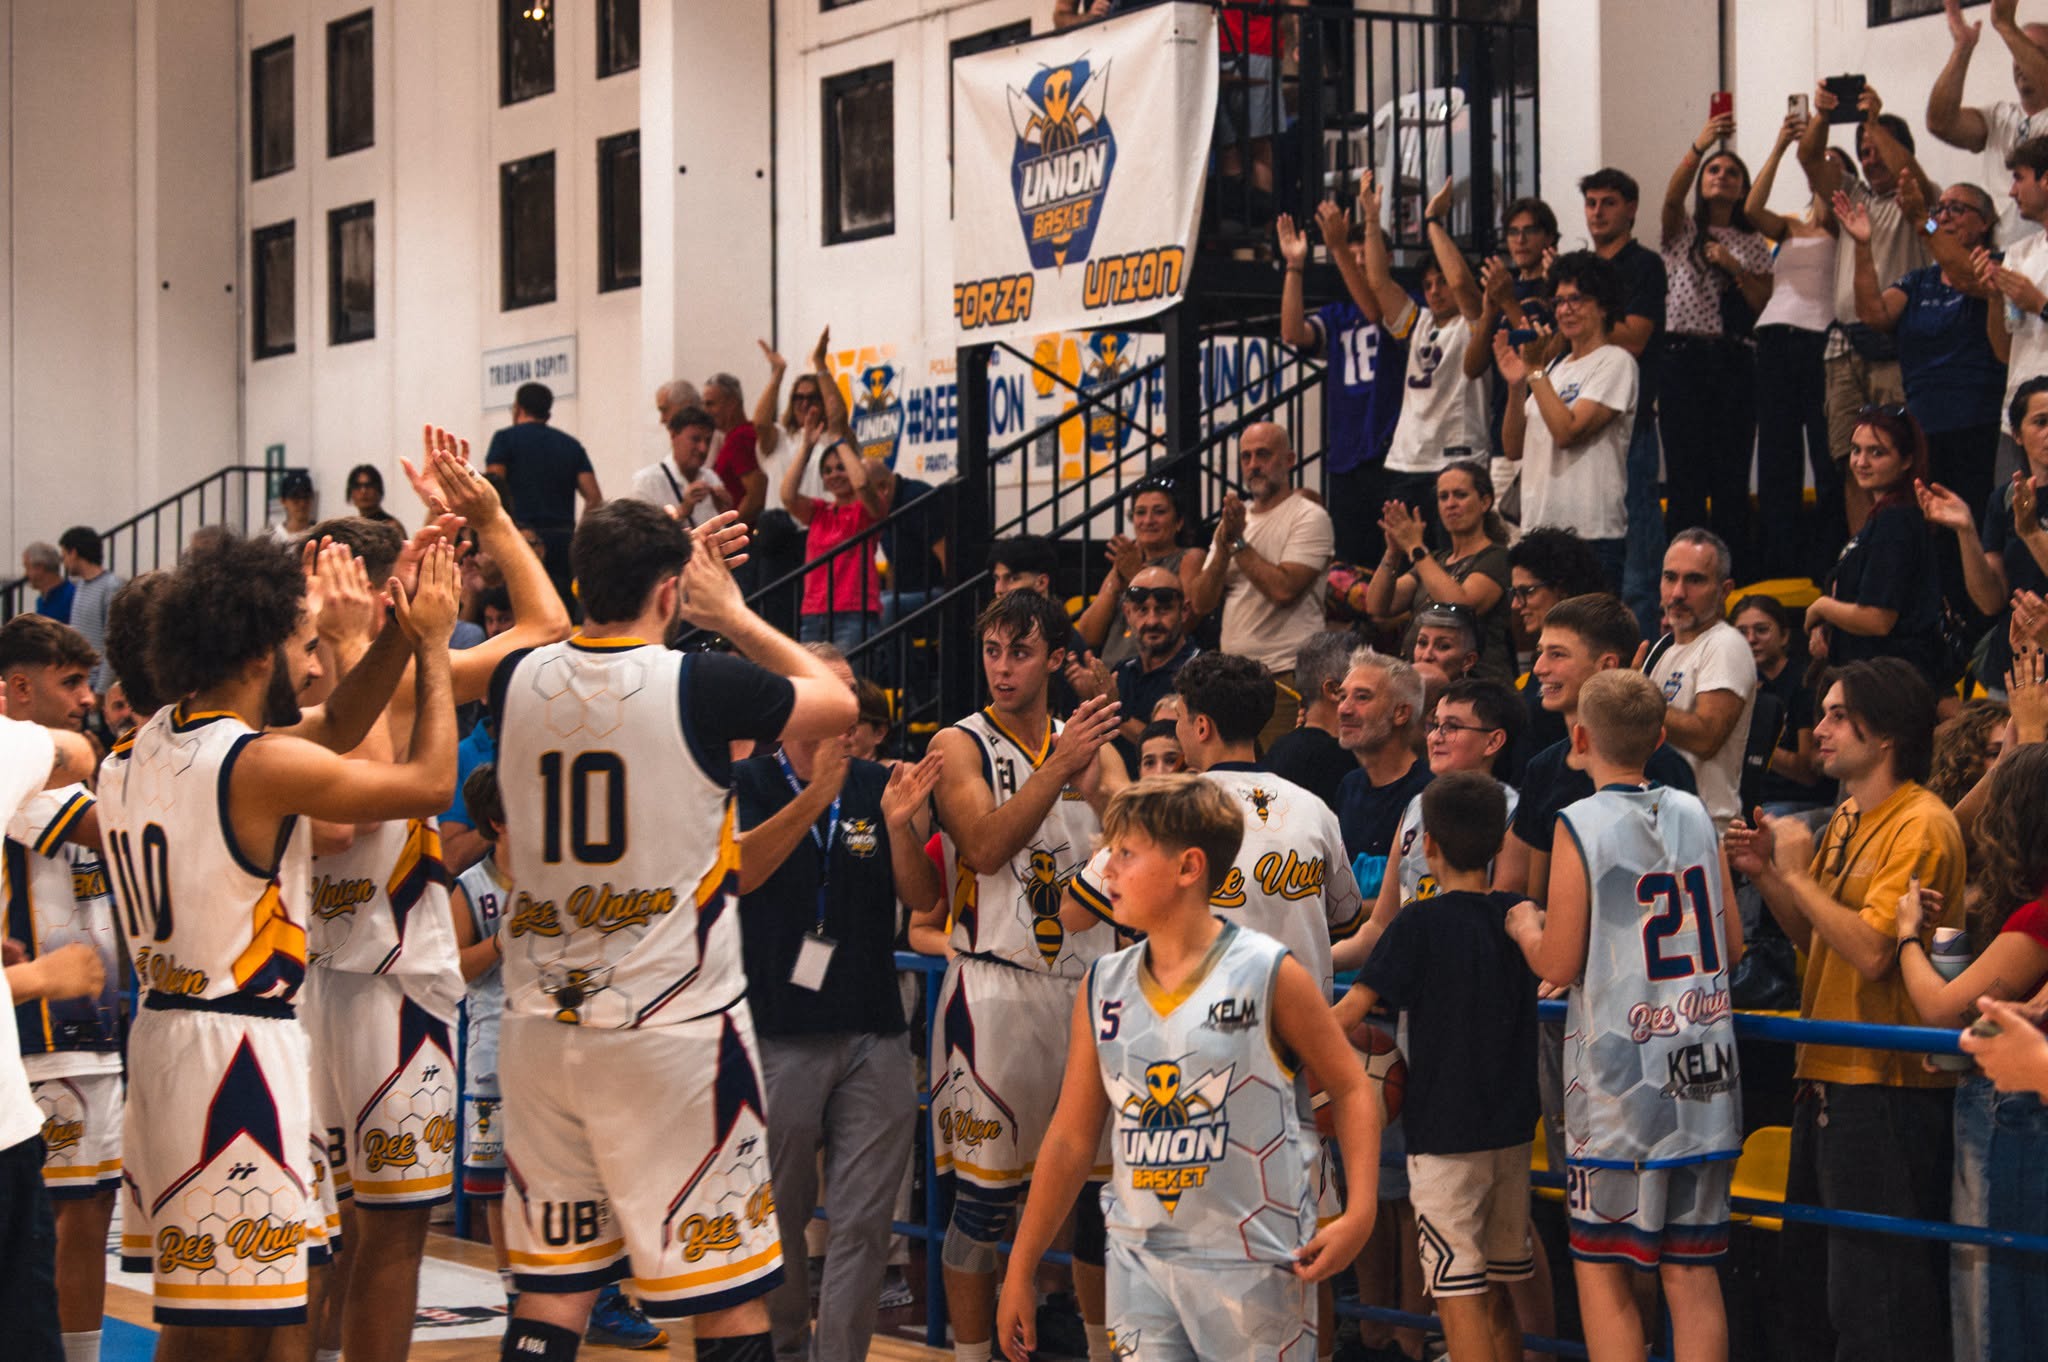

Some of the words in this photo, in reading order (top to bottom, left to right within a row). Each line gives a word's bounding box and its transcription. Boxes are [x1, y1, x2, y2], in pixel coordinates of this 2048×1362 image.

[1022, 142, 1107, 208] UNION
[1032, 199, 1092, 240] BASKET
[1083, 244, 1185, 310] UNION
[490, 360, 530, 387] TRIBUNA
[535, 353, 567, 378] OSPITI
[856, 411, 900, 444] UNION
[539, 750, 628, 866] 10
[567, 883, 677, 934] Union
[1637, 866, 1720, 982] 21
[1208, 997, 1256, 1024] KELM
[364, 1128, 419, 1173] Bee
[1122, 1124, 1229, 1166] UNION
[1132, 1166, 1208, 1189] BASKET
[543, 1200, 598, 1246] UB
[677, 1212, 742, 1263] Bee
[159, 1225, 217, 1273] Bee
